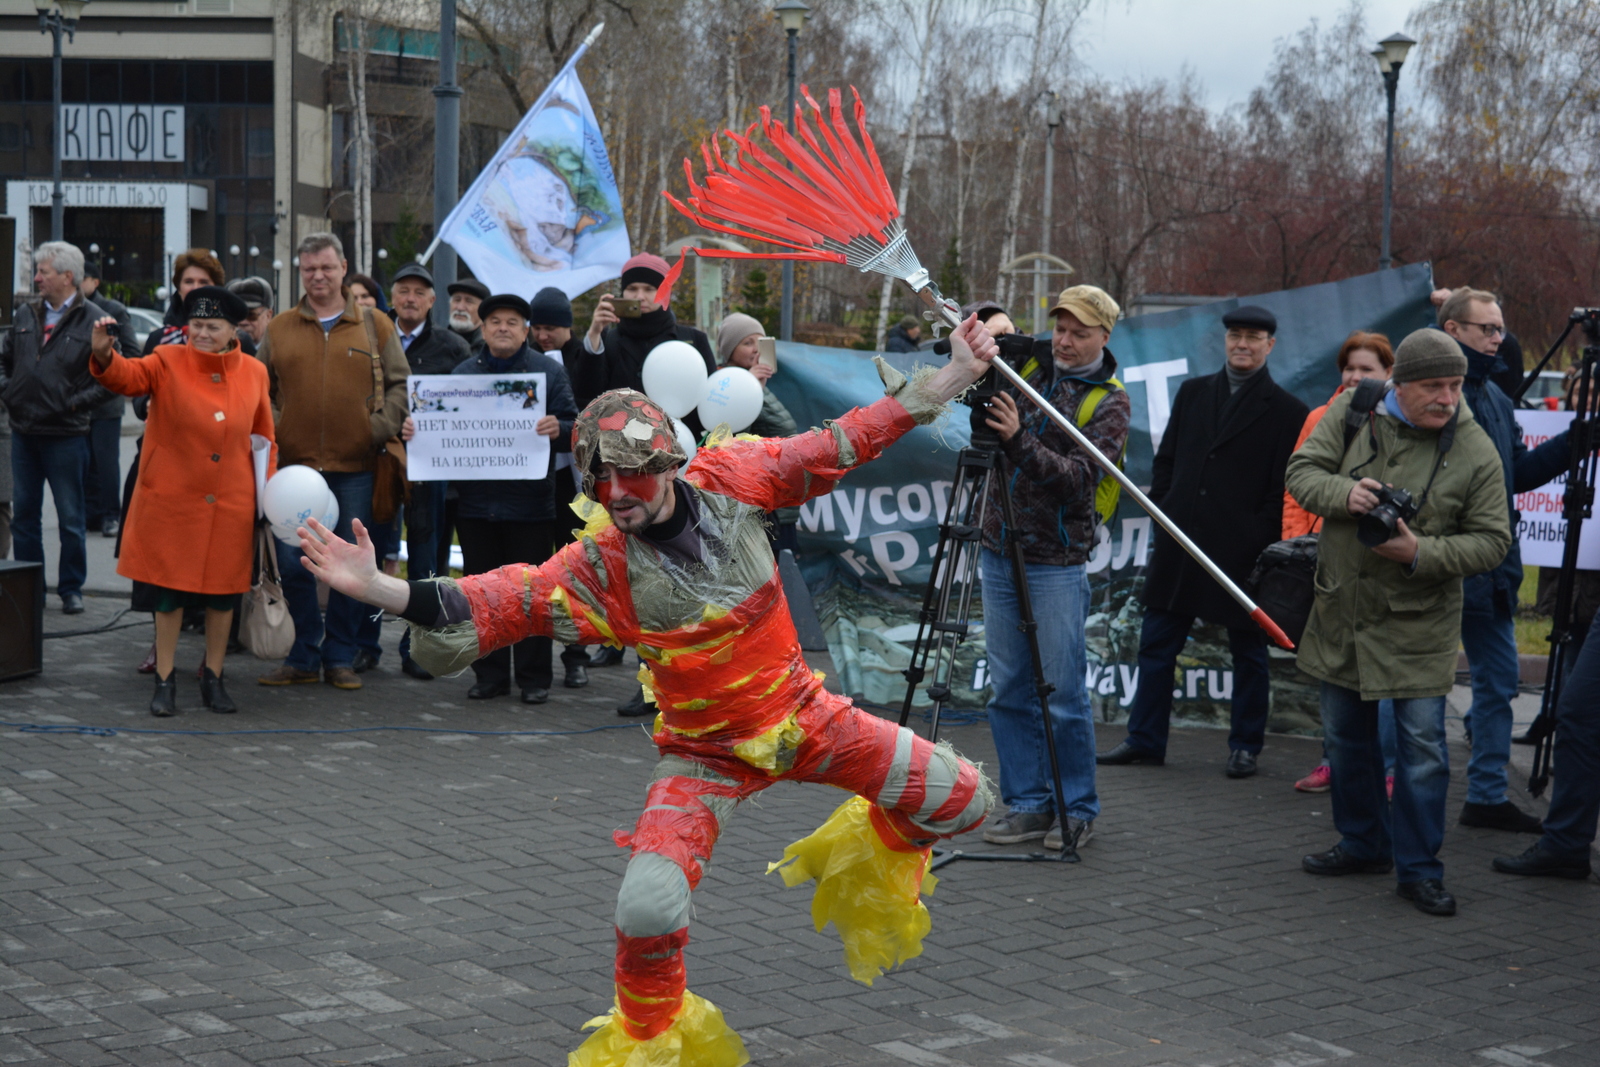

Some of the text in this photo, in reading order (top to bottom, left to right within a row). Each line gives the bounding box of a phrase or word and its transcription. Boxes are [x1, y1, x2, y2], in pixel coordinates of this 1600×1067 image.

[65, 106, 177, 159] КАФЕ
[28, 184, 118, 205] КВРТИРА
[418, 419, 535, 431] НЕТ МУСОРНОМУ
[441, 437, 515, 449] ПОЛИГОНУ
[431, 453, 528, 468] НА ИЗДРЕВОЙ!
[796, 480, 979, 544] мусор
